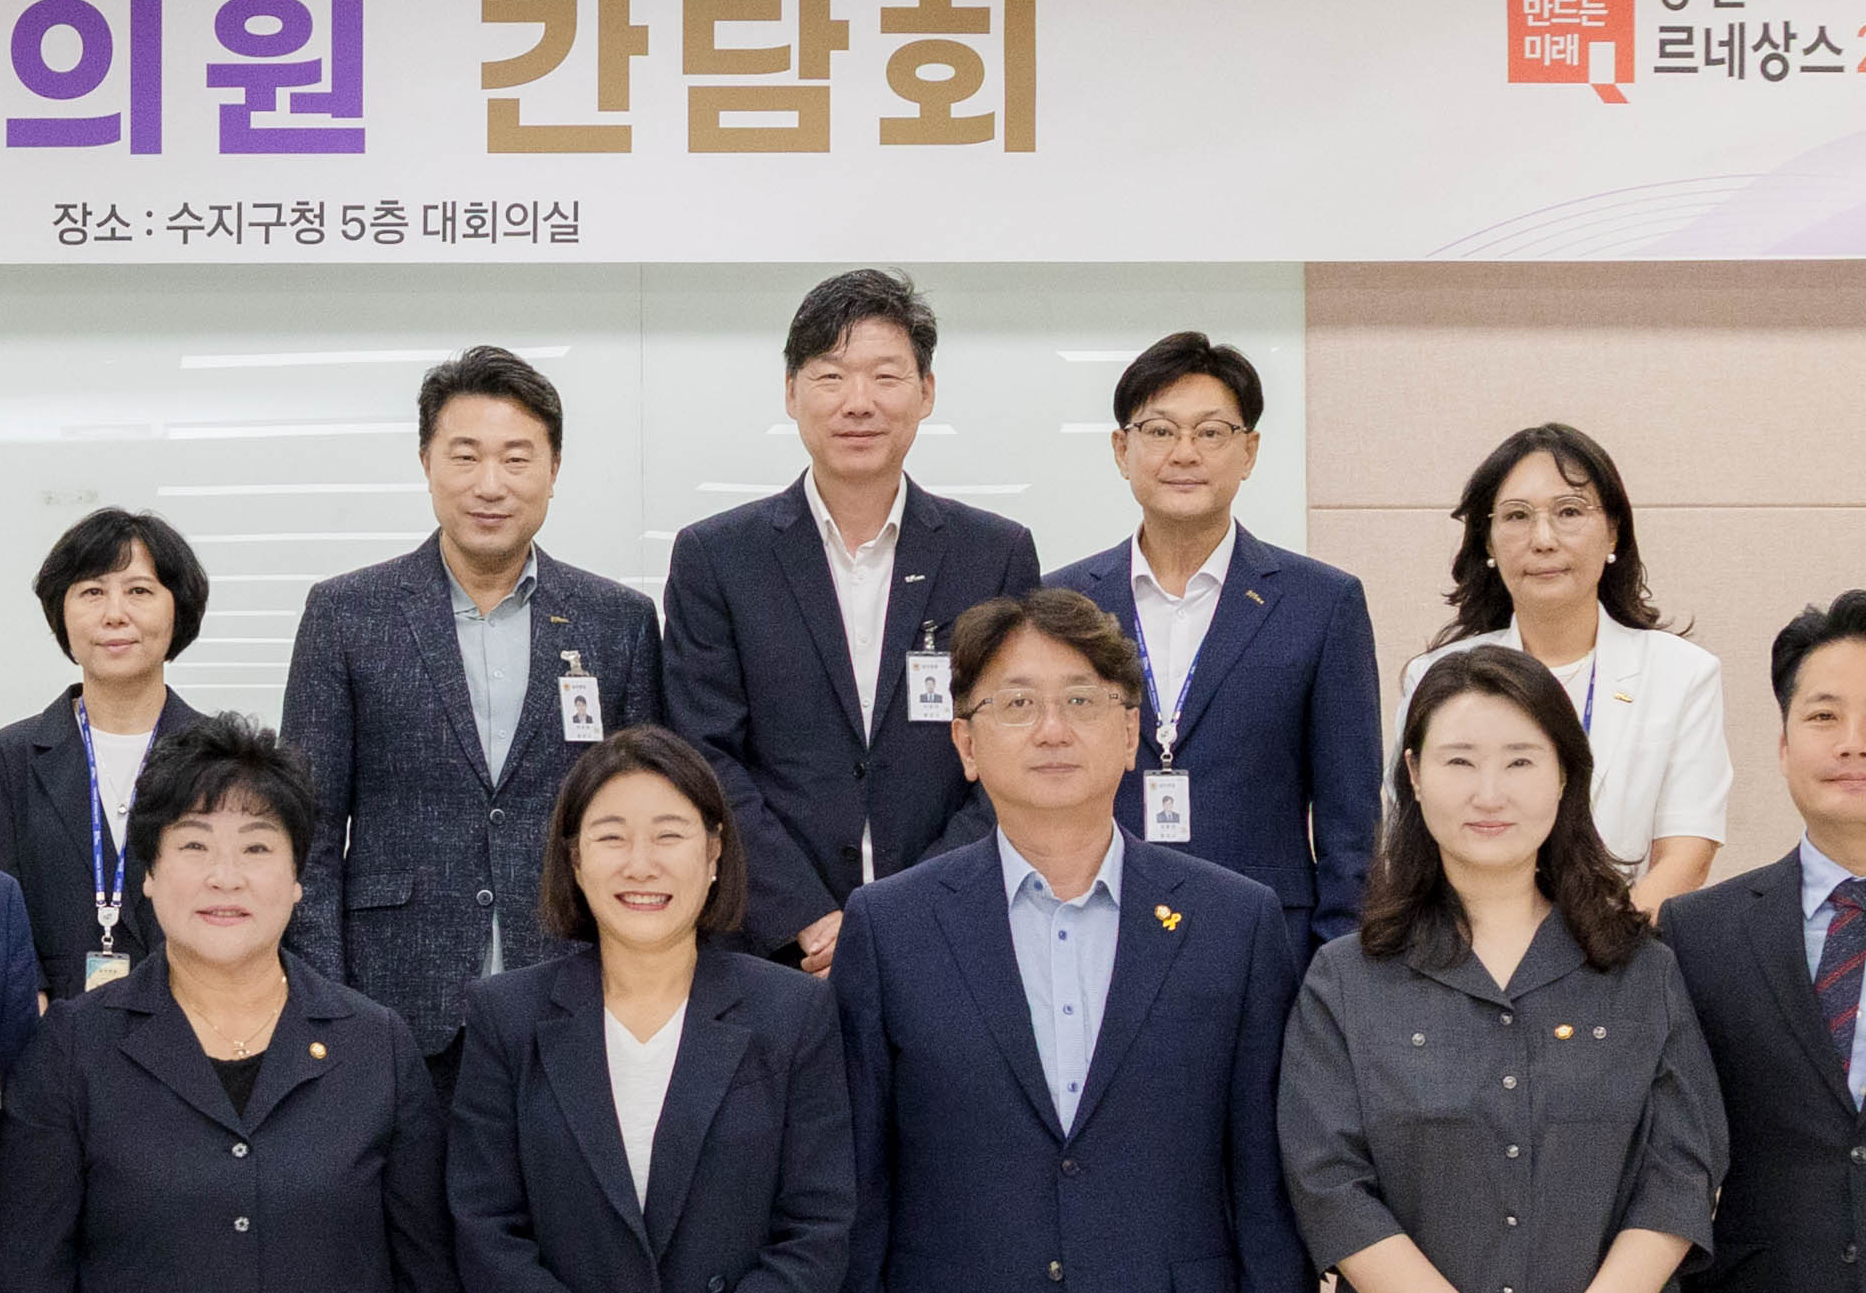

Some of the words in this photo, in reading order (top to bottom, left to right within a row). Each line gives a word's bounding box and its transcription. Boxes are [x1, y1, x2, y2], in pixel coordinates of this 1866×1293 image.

[1524, 34, 1580, 67] 미래
[1654, 20, 1846, 84] 르네상스
[166, 201, 327, 246] 수지구청
[342, 200, 410, 246] 5층
[423, 201, 581, 246] 대회의실
